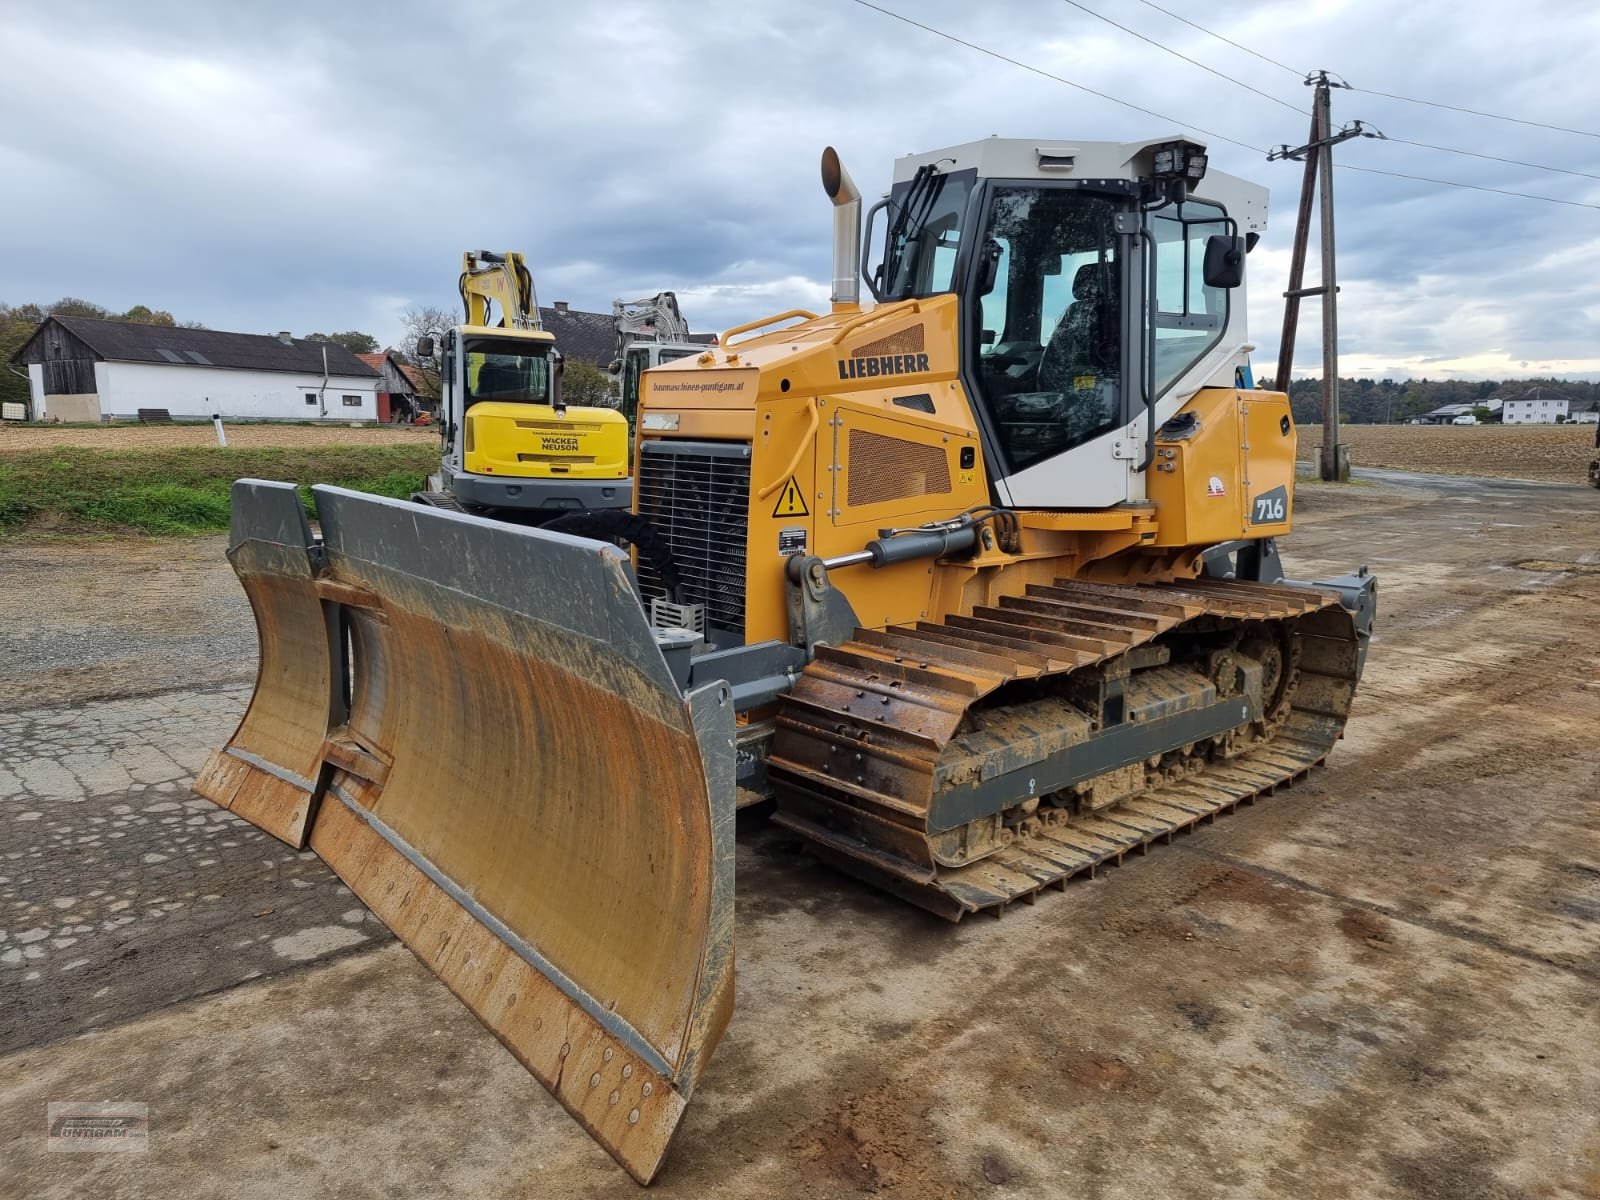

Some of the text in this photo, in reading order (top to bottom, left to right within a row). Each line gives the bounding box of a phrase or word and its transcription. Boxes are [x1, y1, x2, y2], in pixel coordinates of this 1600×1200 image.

[838, 353, 930, 380] LIEBHERR
[652, 381, 745, 393] baumaschinen-puntigam.at
[541, 437, 578, 445] WACKER
[541, 443, 579, 451] NEUSON
[1256, 498, 1284, 520] 716
